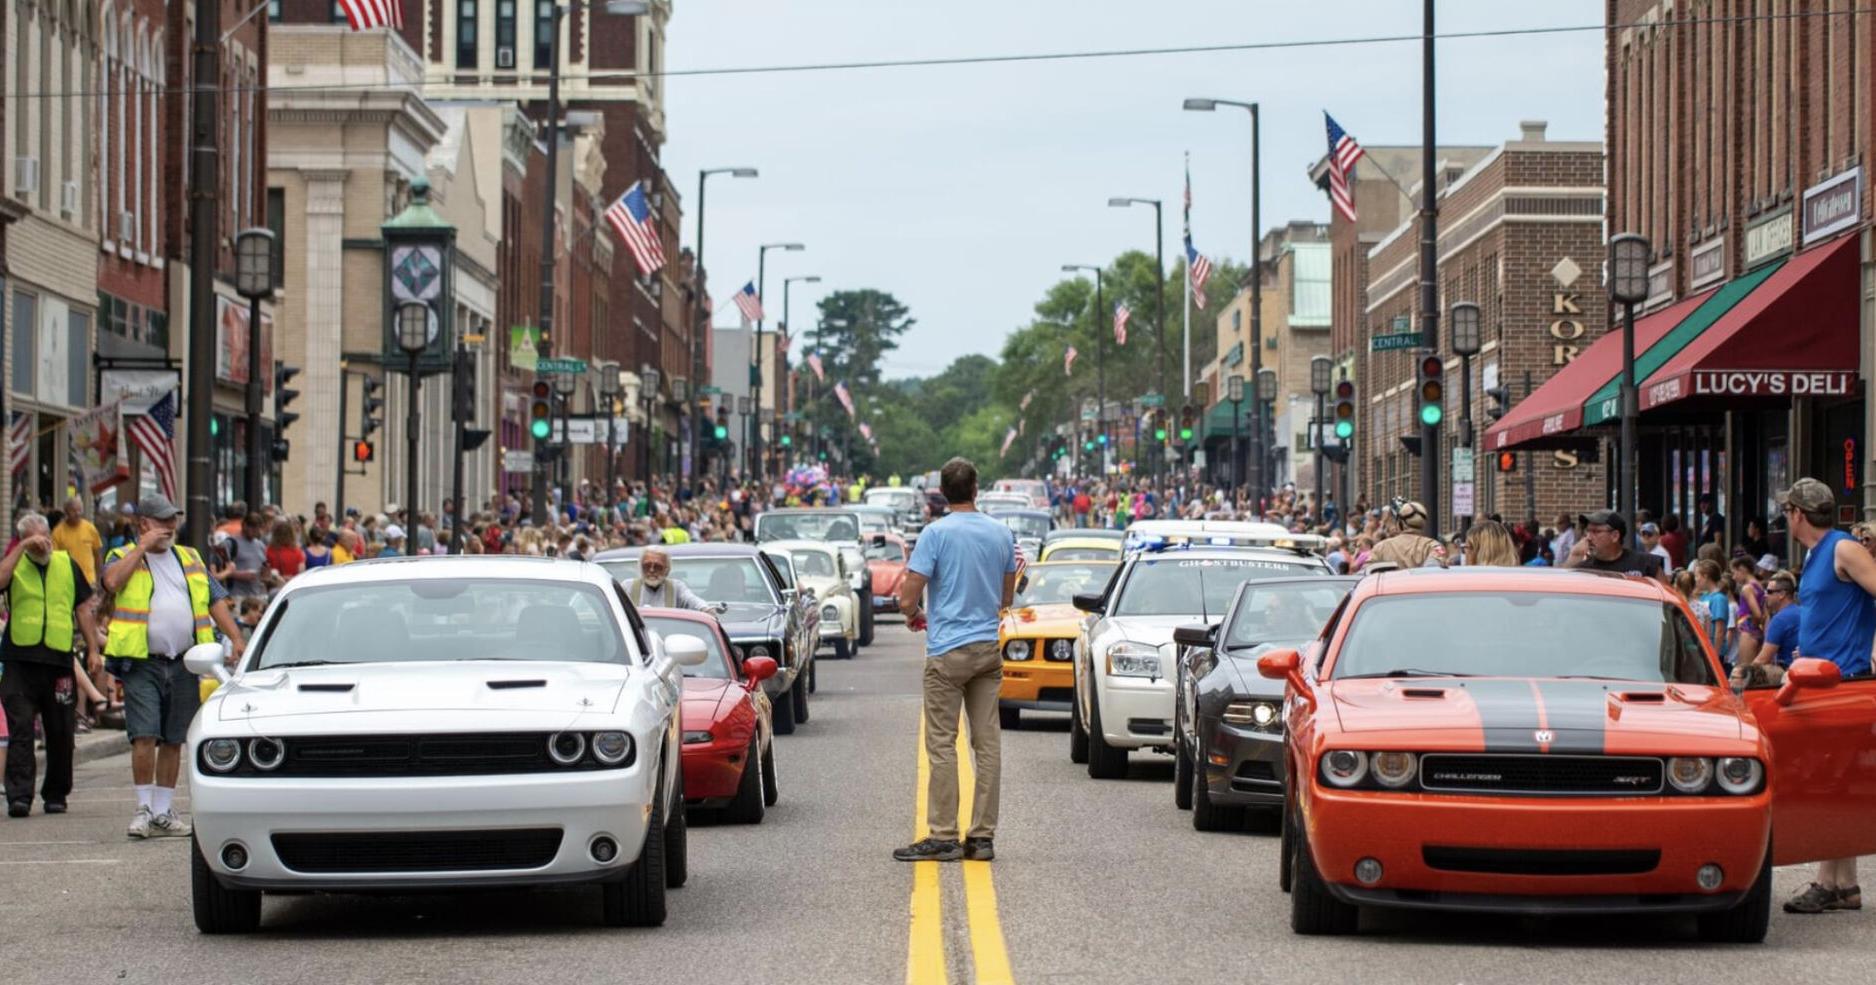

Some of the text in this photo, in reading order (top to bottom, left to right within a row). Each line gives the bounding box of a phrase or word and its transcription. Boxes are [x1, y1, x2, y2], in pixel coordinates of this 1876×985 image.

[1372, 336, 1416, 348] CENTRAL
[1696, 373, 1785, 394] LUCY'S
[1792, 374, 1847, 394] DELI
[1843, 438, 1854, 489] OPEN
[1434, 772, 1502, 781] CHALLENGER
